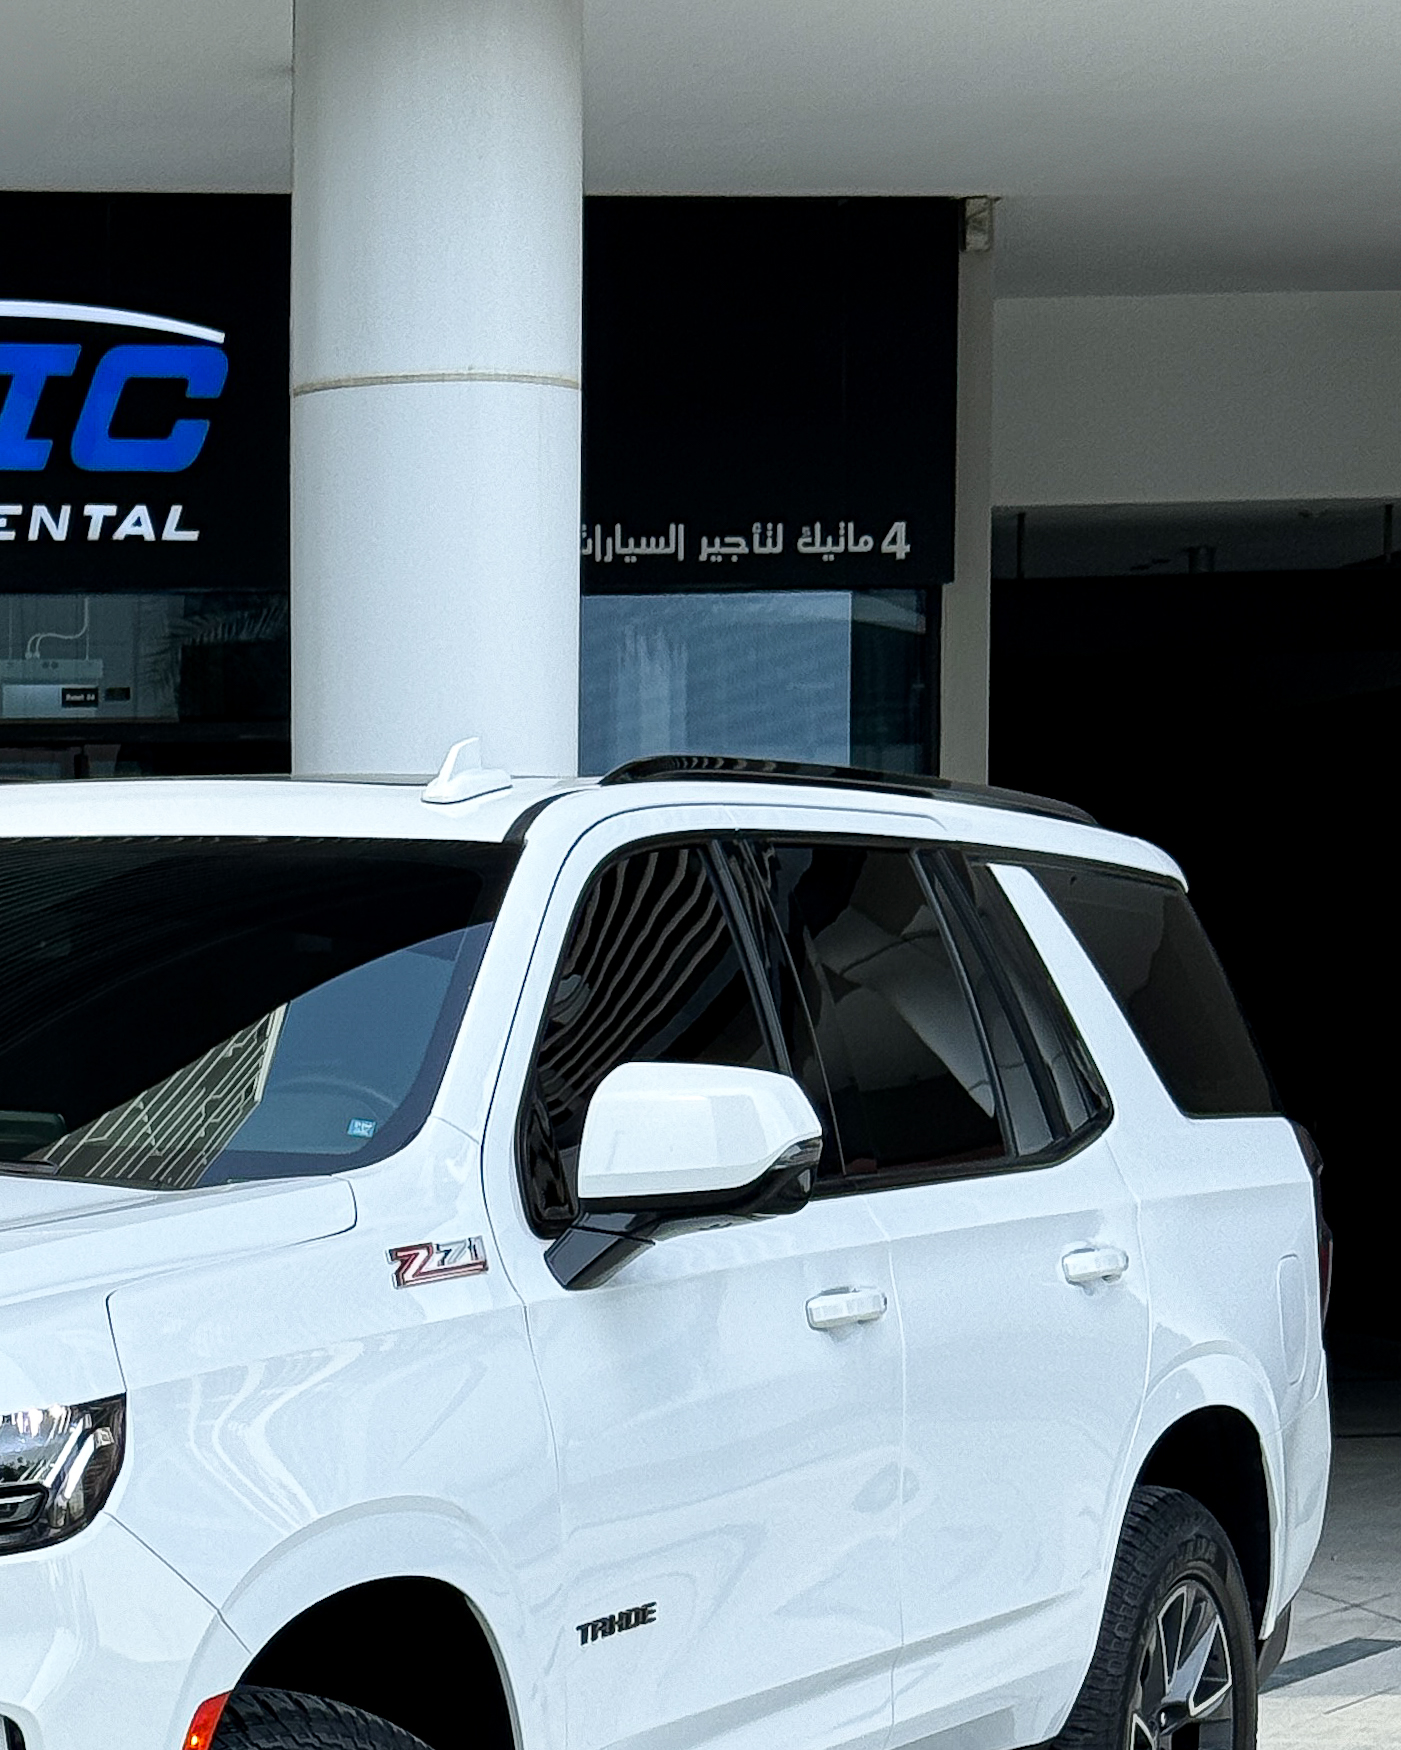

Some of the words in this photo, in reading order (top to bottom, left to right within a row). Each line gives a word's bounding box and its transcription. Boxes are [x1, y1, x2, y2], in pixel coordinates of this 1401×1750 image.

[698, 522, 784, 562] لتأجير
[797, 521, 874, 562] ماتيك
[881, 521, 911, 560] 4
[386, 1236, 488, 1289] Z71
[575, 1601, 657, 1647] TAHOE
